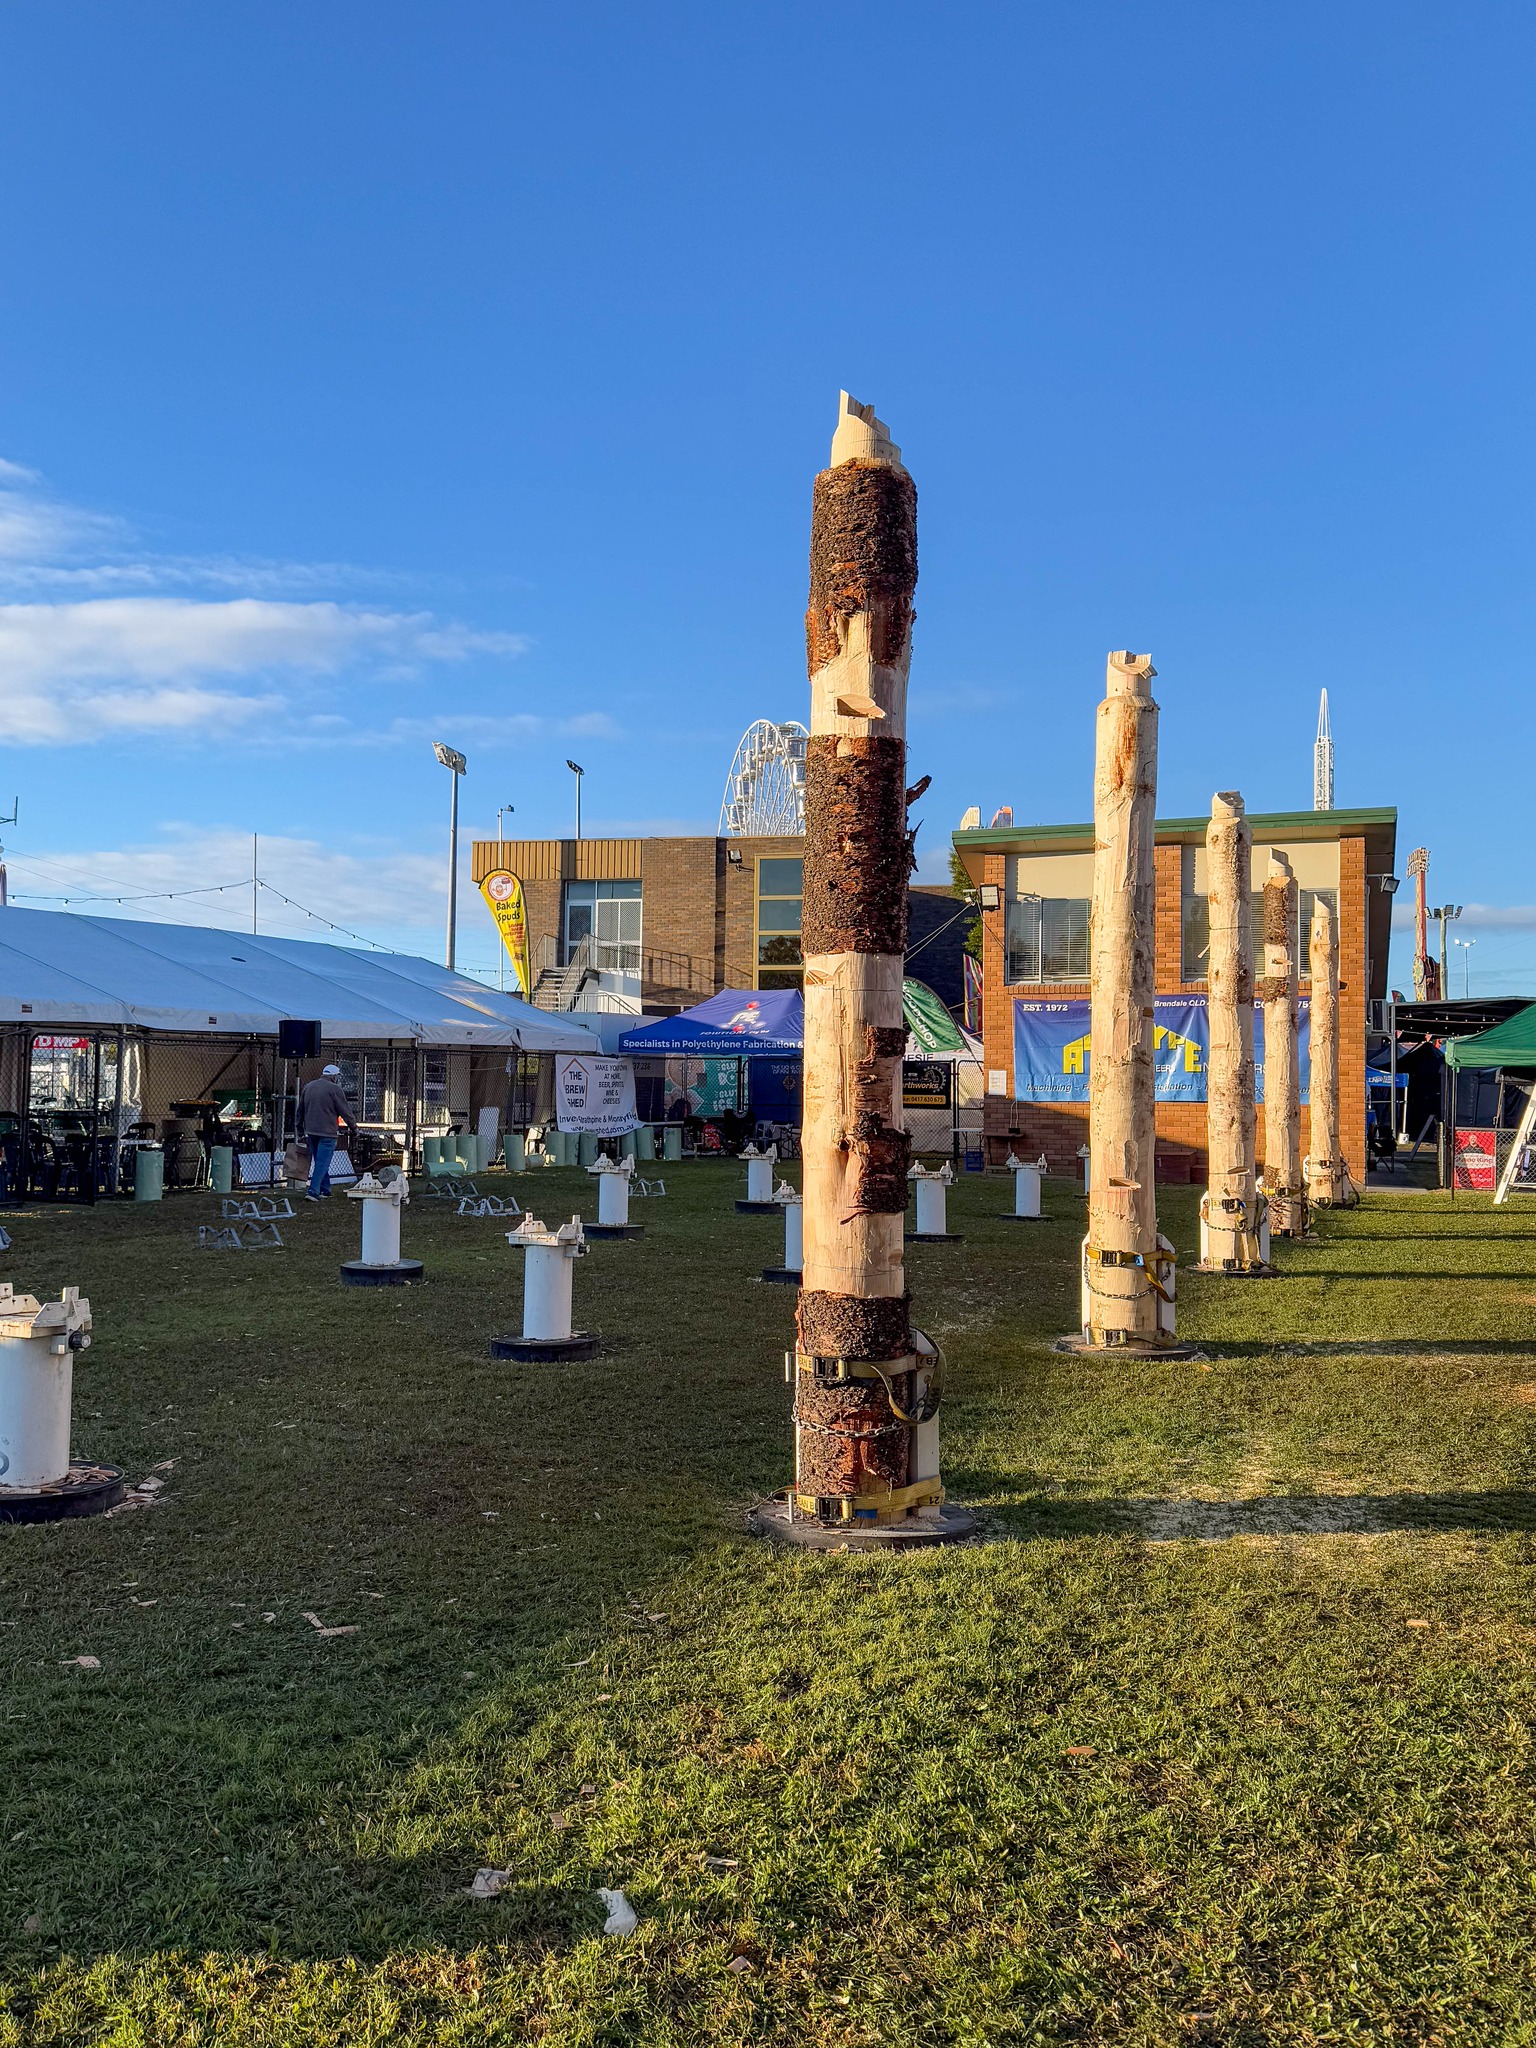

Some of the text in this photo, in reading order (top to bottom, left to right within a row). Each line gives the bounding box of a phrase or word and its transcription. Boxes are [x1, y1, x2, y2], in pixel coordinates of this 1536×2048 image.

[496, 900, 520, 911] Baked
[498, 911, 520, 923] Spuds
[623, 1039, 804, 1050] Specialists in Polyethylene Fabrication &
[568, 1071, 583, 1080] THE
[565, 1084, 586, 1094] BREW
[1027, 1083, 1072, 1093] Machining
[567, 1098, 584, 1108] SHED
